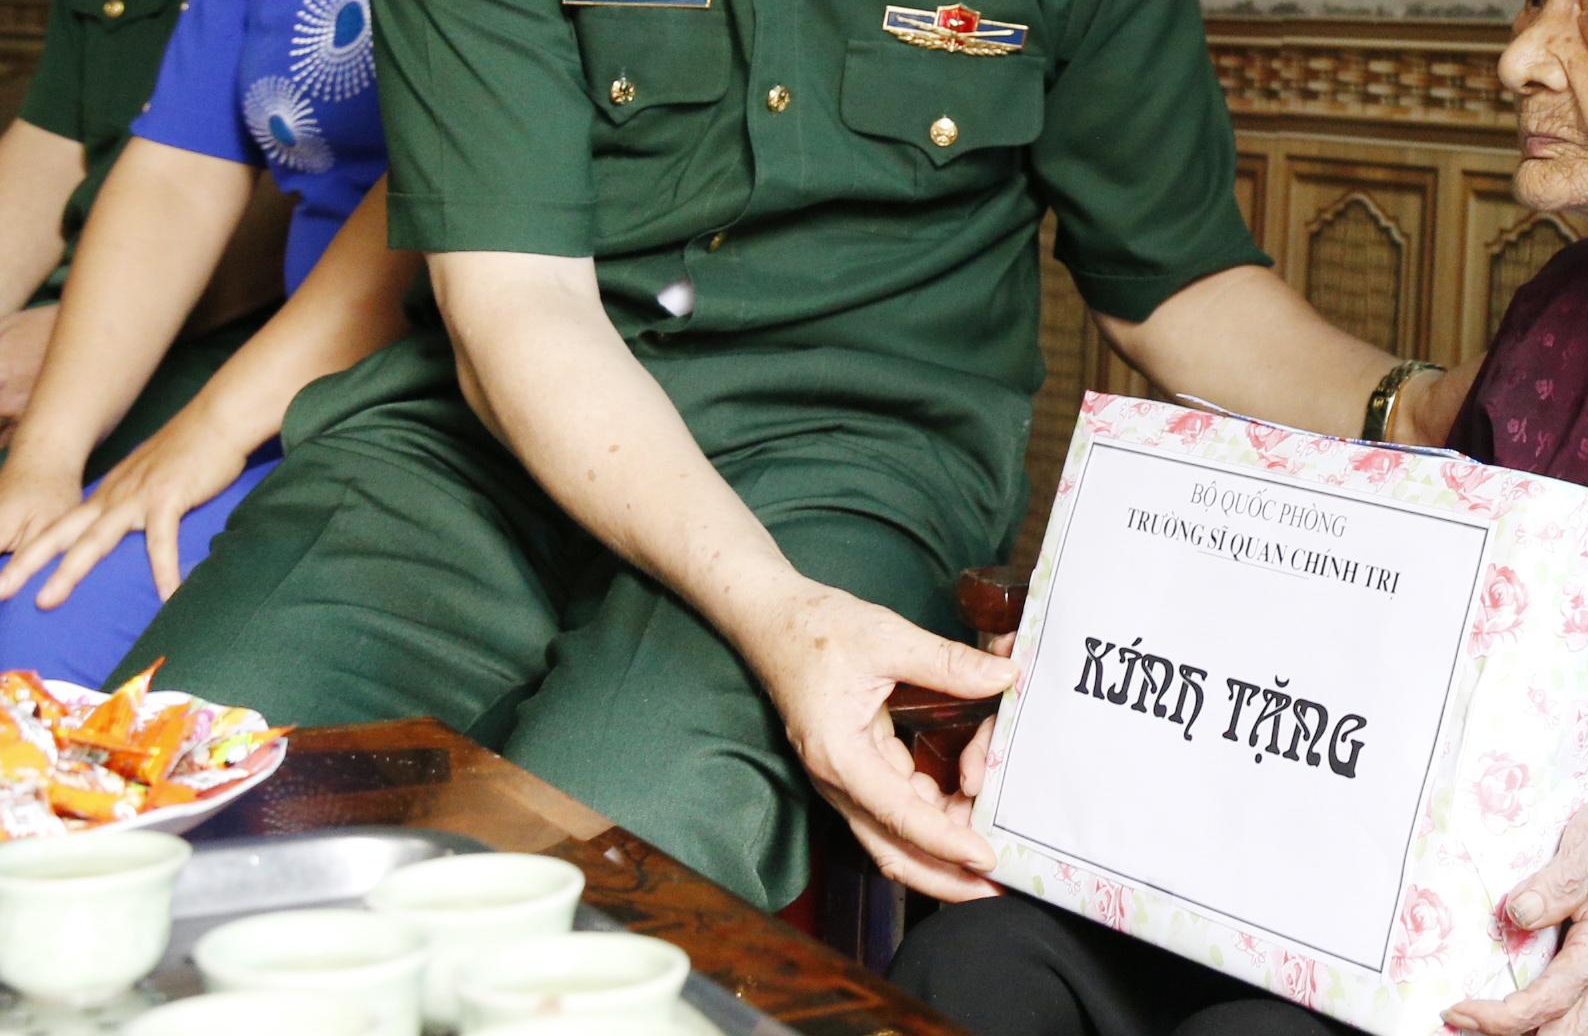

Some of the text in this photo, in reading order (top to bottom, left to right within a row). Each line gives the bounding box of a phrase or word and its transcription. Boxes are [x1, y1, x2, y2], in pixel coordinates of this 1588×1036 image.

[1126, 507, 1401, 601] TRƯỜNG SĨ QUAN CHÍNH TRỊ
[1190, 480, 1348, 539] BỘ QUỐC PHÒNG
[1074, 636, 1367, 779] KÍNH TẶNG
